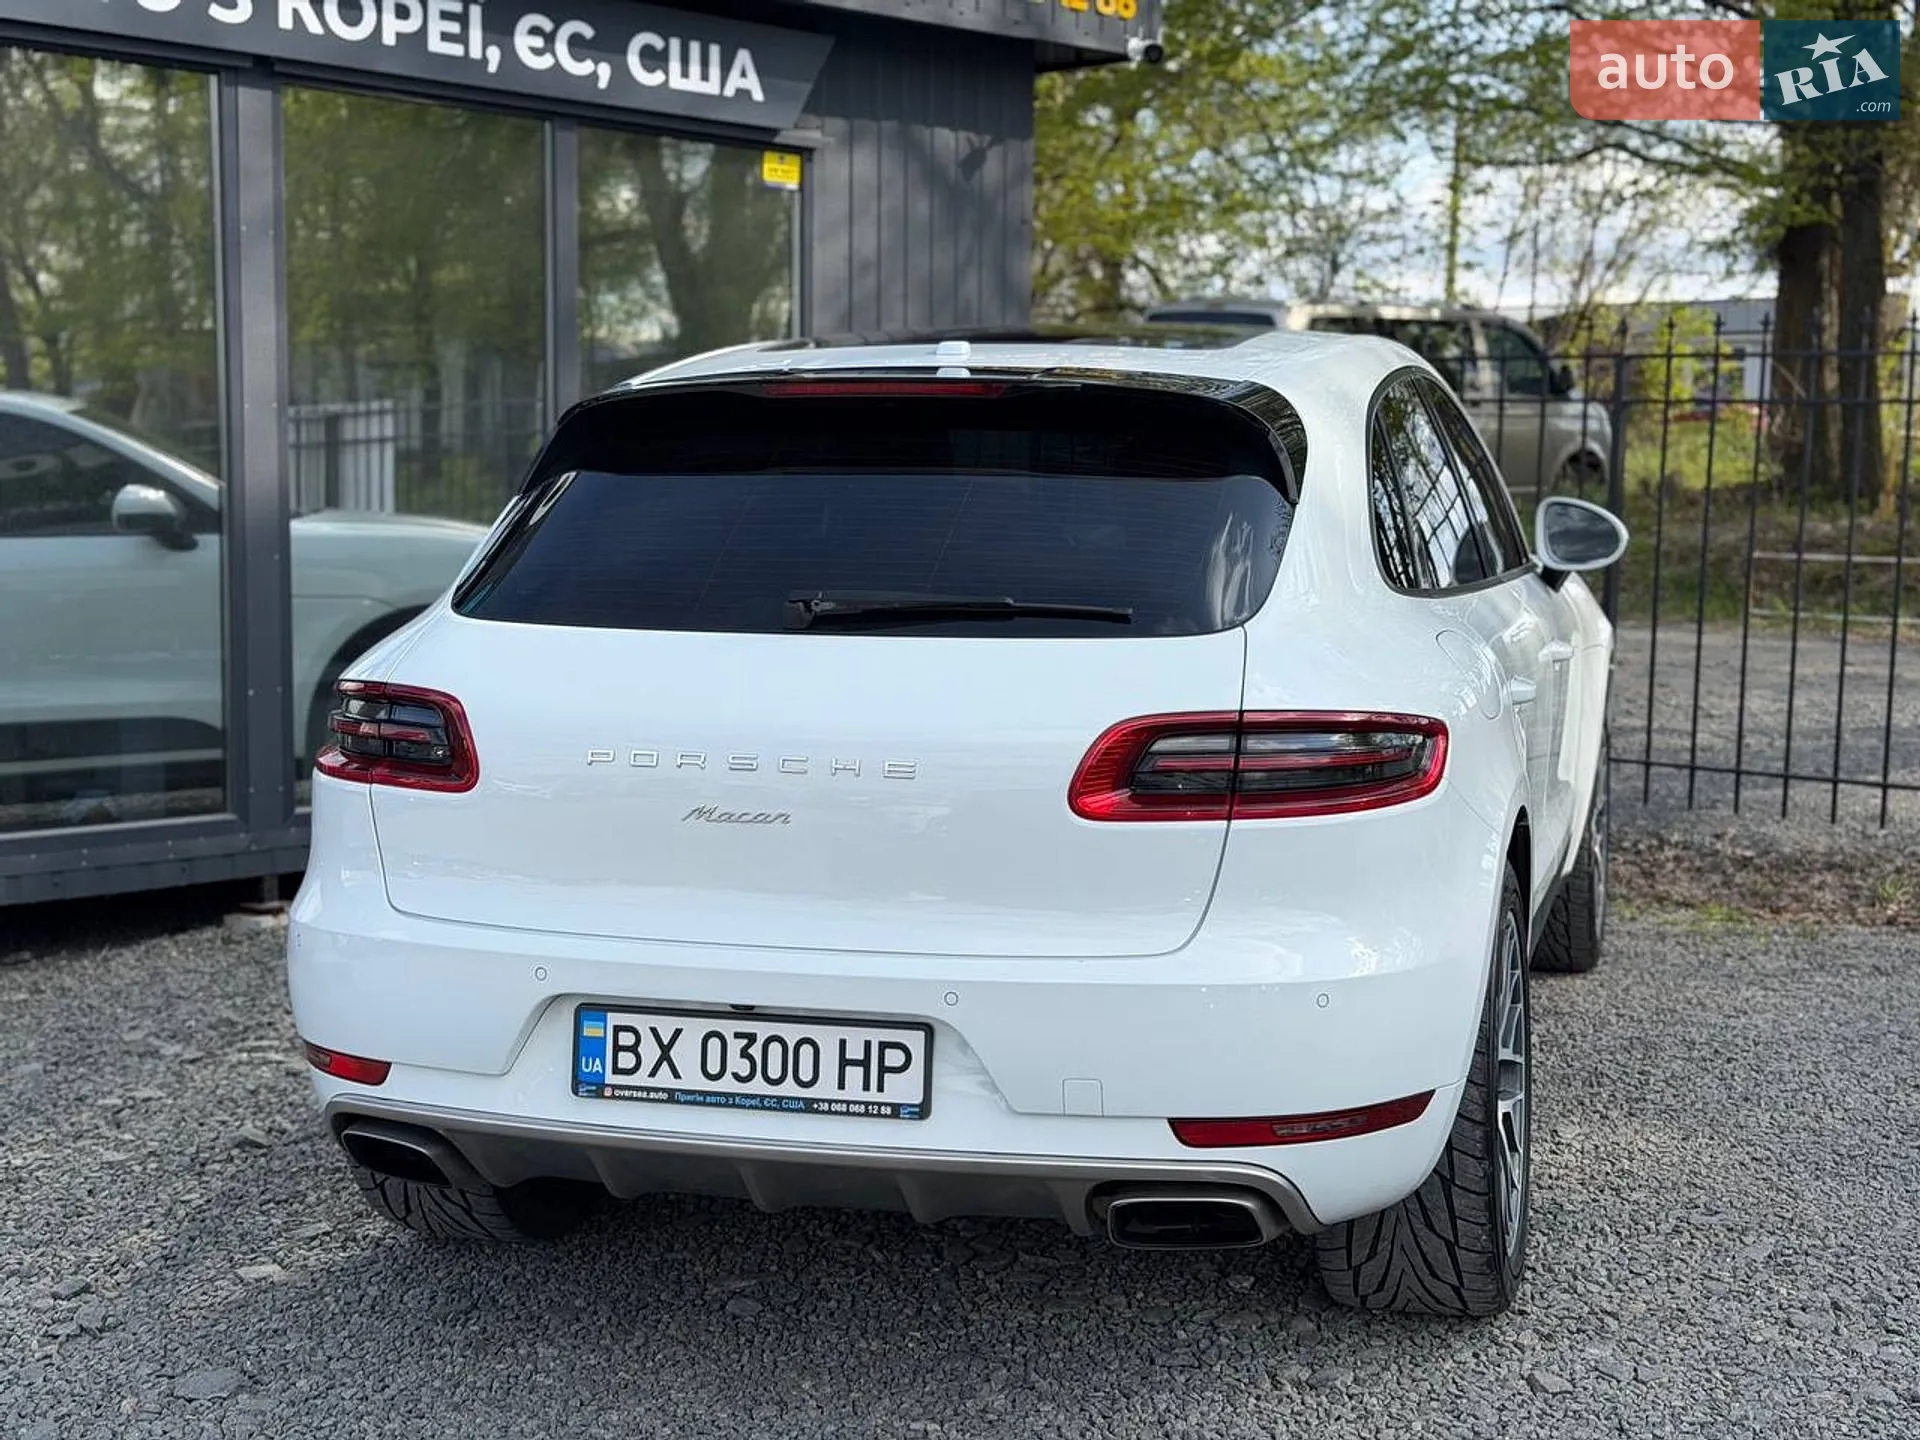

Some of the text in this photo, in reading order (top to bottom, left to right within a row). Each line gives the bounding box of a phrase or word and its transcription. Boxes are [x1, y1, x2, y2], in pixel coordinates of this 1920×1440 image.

[513, 12, 612, 90] ЄС,
[626, 31, 765, 103] США
[587, 749, 917, 779] PORSCHE
[681, 803, 792, 825] Macan
[581, 1056, 602, 1074] UA
[611, 1024, 913, 1093] BX 0300 HP
[813, 1101, 829, 1112] +38
